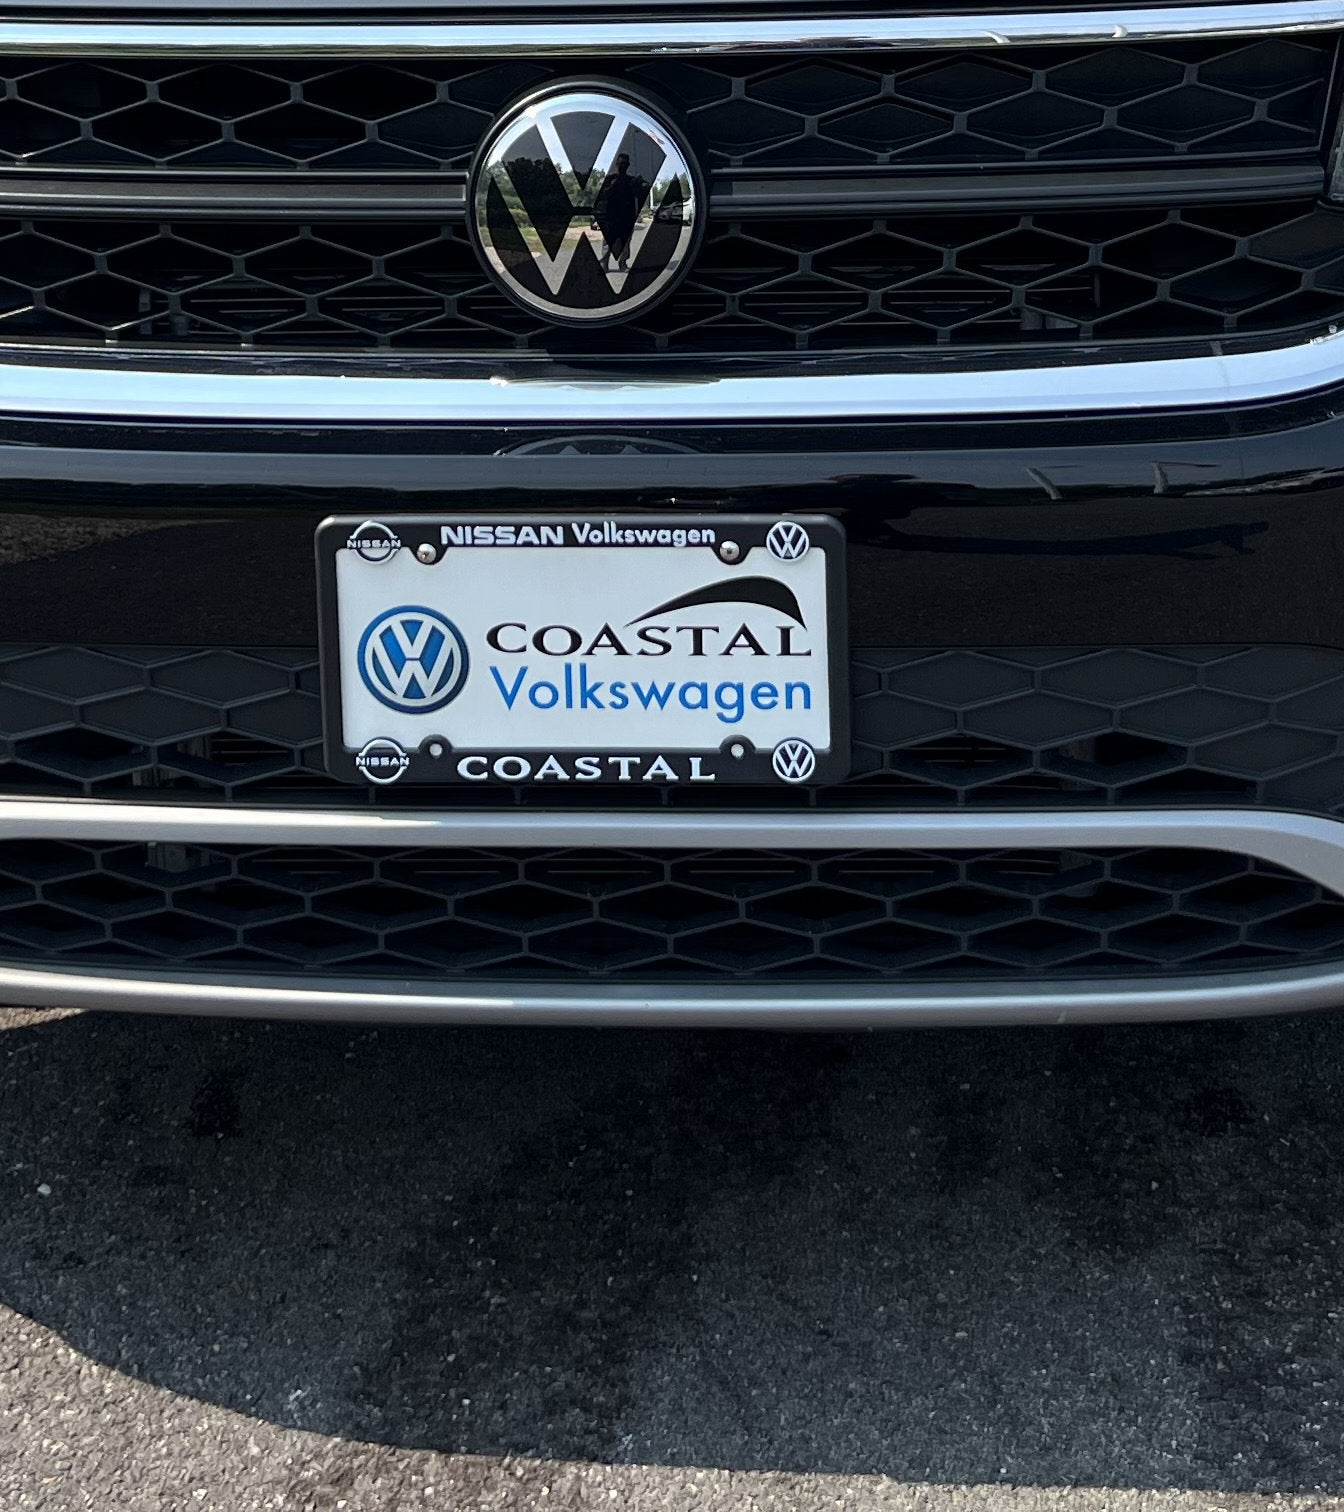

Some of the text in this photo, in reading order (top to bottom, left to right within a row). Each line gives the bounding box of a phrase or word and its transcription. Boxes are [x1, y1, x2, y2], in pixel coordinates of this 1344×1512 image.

[440, 521, 716, 547] NISSAN Volkswagen
[485, 621, 812, 657] COASTAL
[488, 662, 812, 723] Volkswagen
[457, 755, 716, 782] COASTAL
